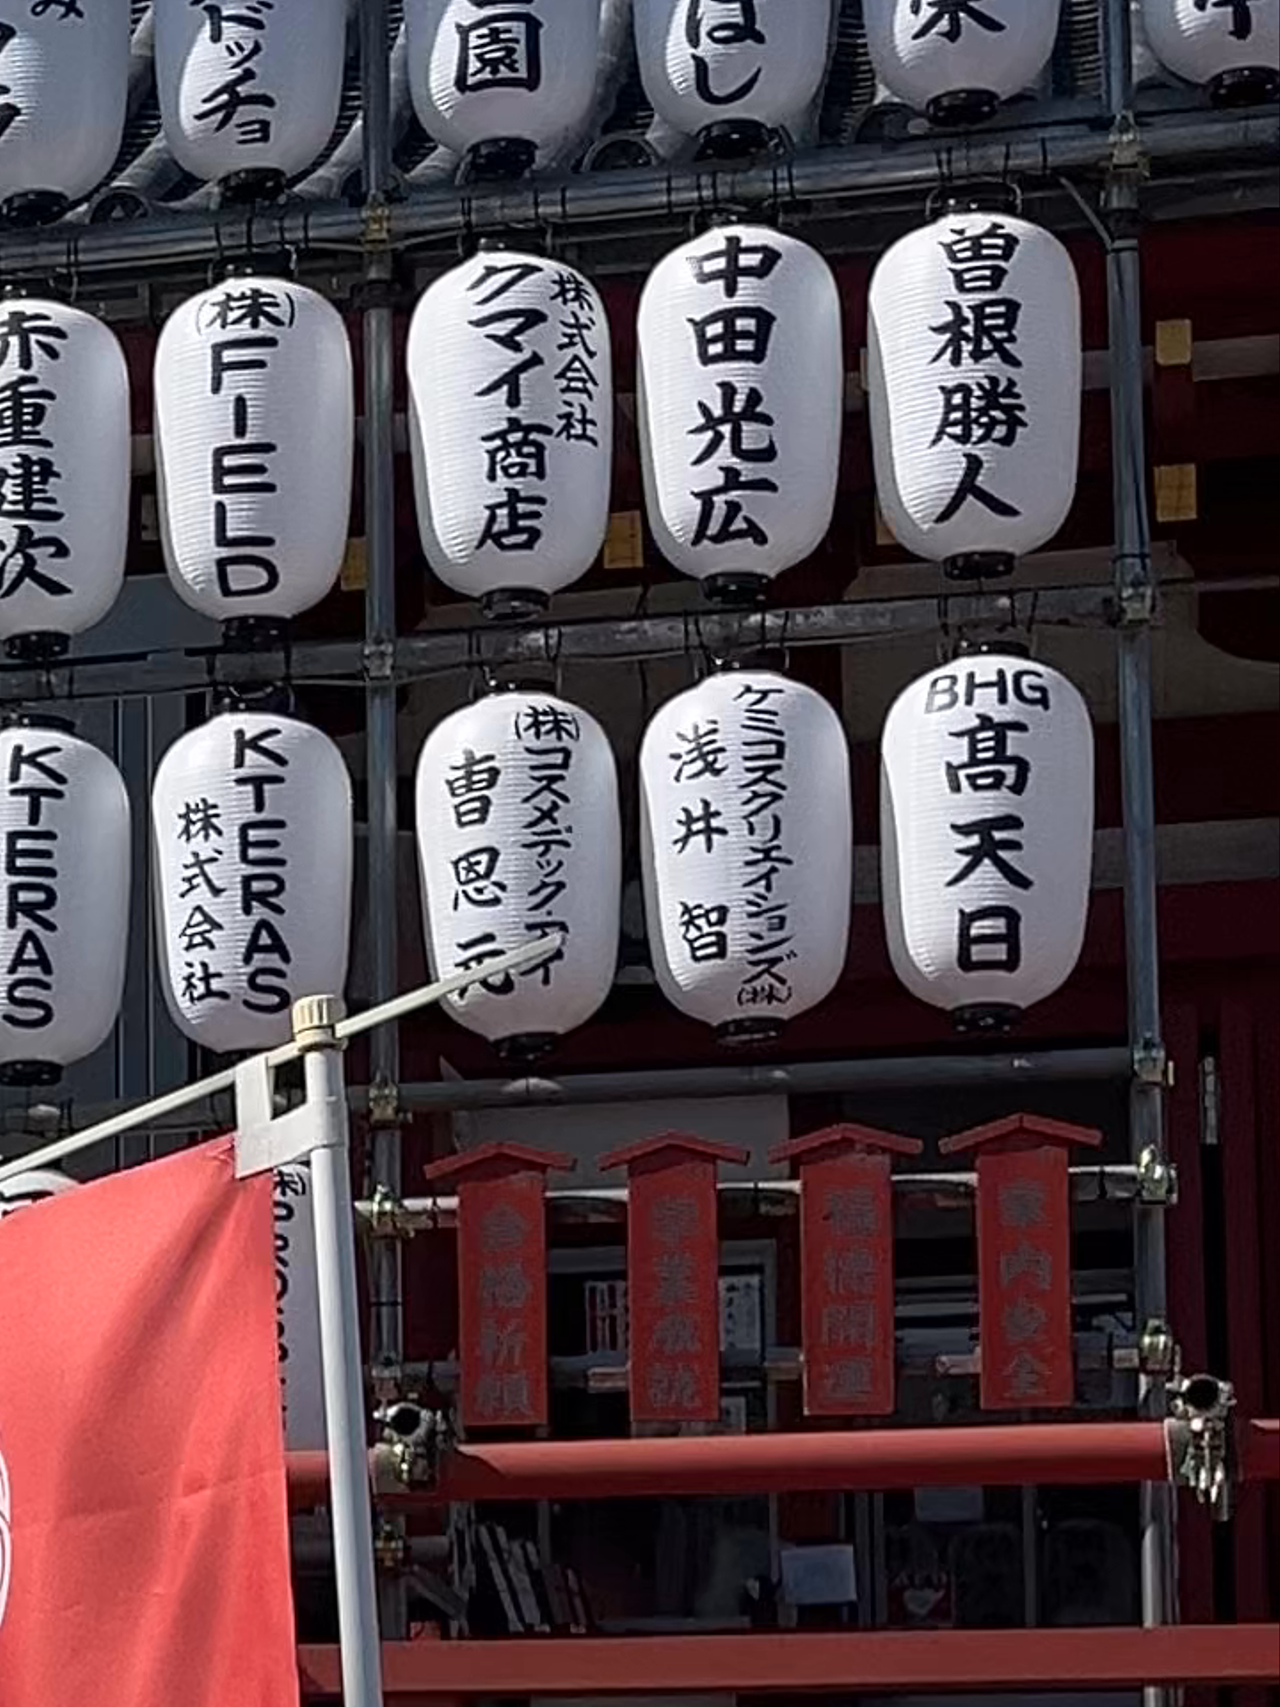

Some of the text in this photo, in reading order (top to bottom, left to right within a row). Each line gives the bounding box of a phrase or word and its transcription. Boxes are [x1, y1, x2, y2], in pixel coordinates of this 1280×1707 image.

[465, 263, 551, 553] クマイ商店
[548, 273, 599, 448] 株式会社
[686, 236, 783, 549] 中田光広
[928, 224, 1030, 526] 曽根勝人
[923, 669, 1052, 715] BHG
[2, 744, 69, 1028] KTERAS
[176, 798, 230, 1005] 株式会社
[233, 728, 291, 1015] KTERAS
